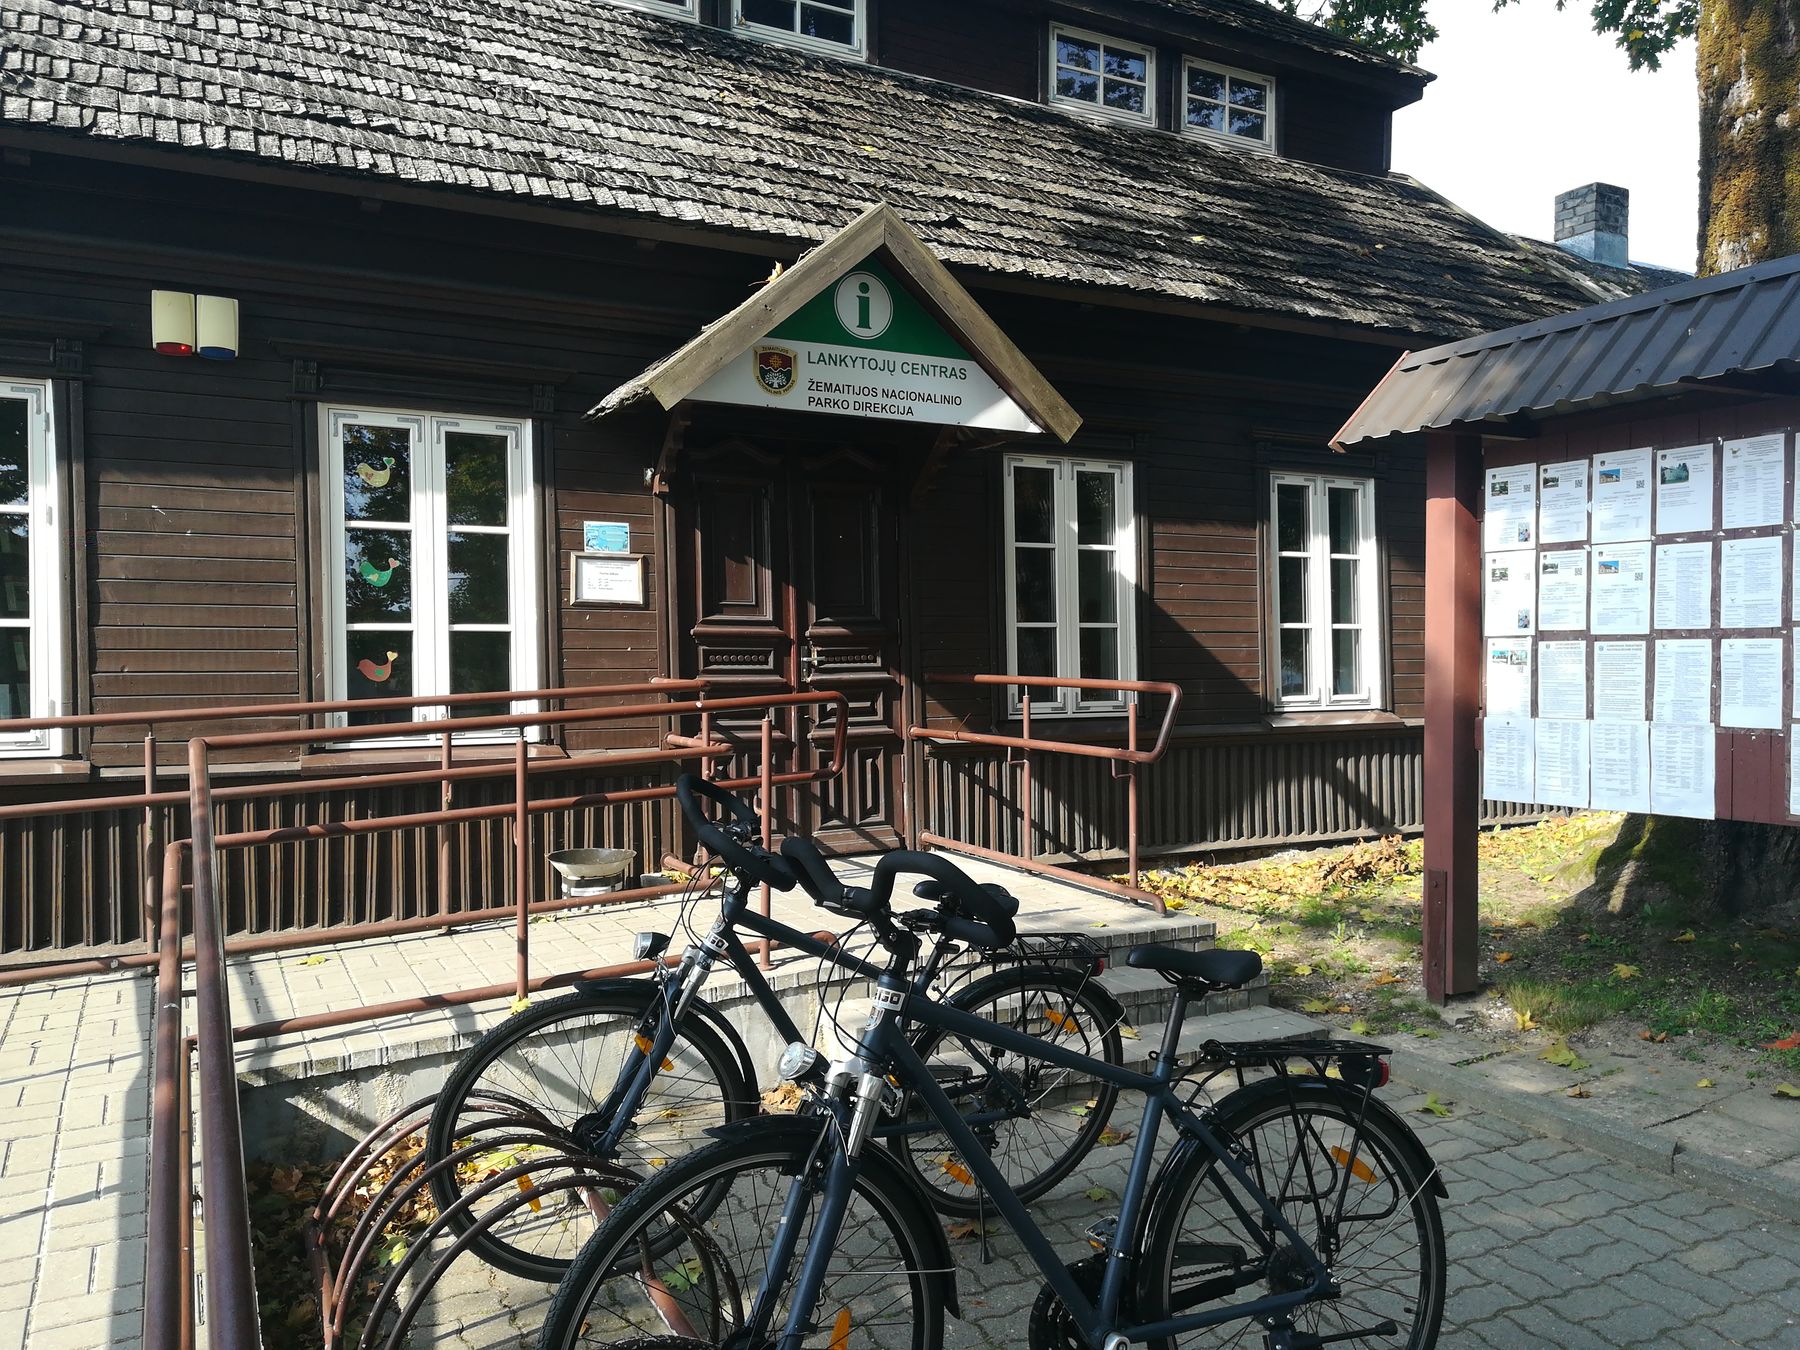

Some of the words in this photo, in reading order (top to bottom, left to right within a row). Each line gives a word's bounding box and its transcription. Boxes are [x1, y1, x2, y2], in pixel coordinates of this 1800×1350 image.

[807, 351, 896, 376] LANKYTOJŲ
[900, 361, 967, 380] CENTRAS
[807, 378, 878, 397] ŽEMAITIJOS
[881, 387, 962, 406] NACIONALINIO
[808, 396, 850, 410] PARKO
[853, 401, 914, 416] DIREKCIJA
